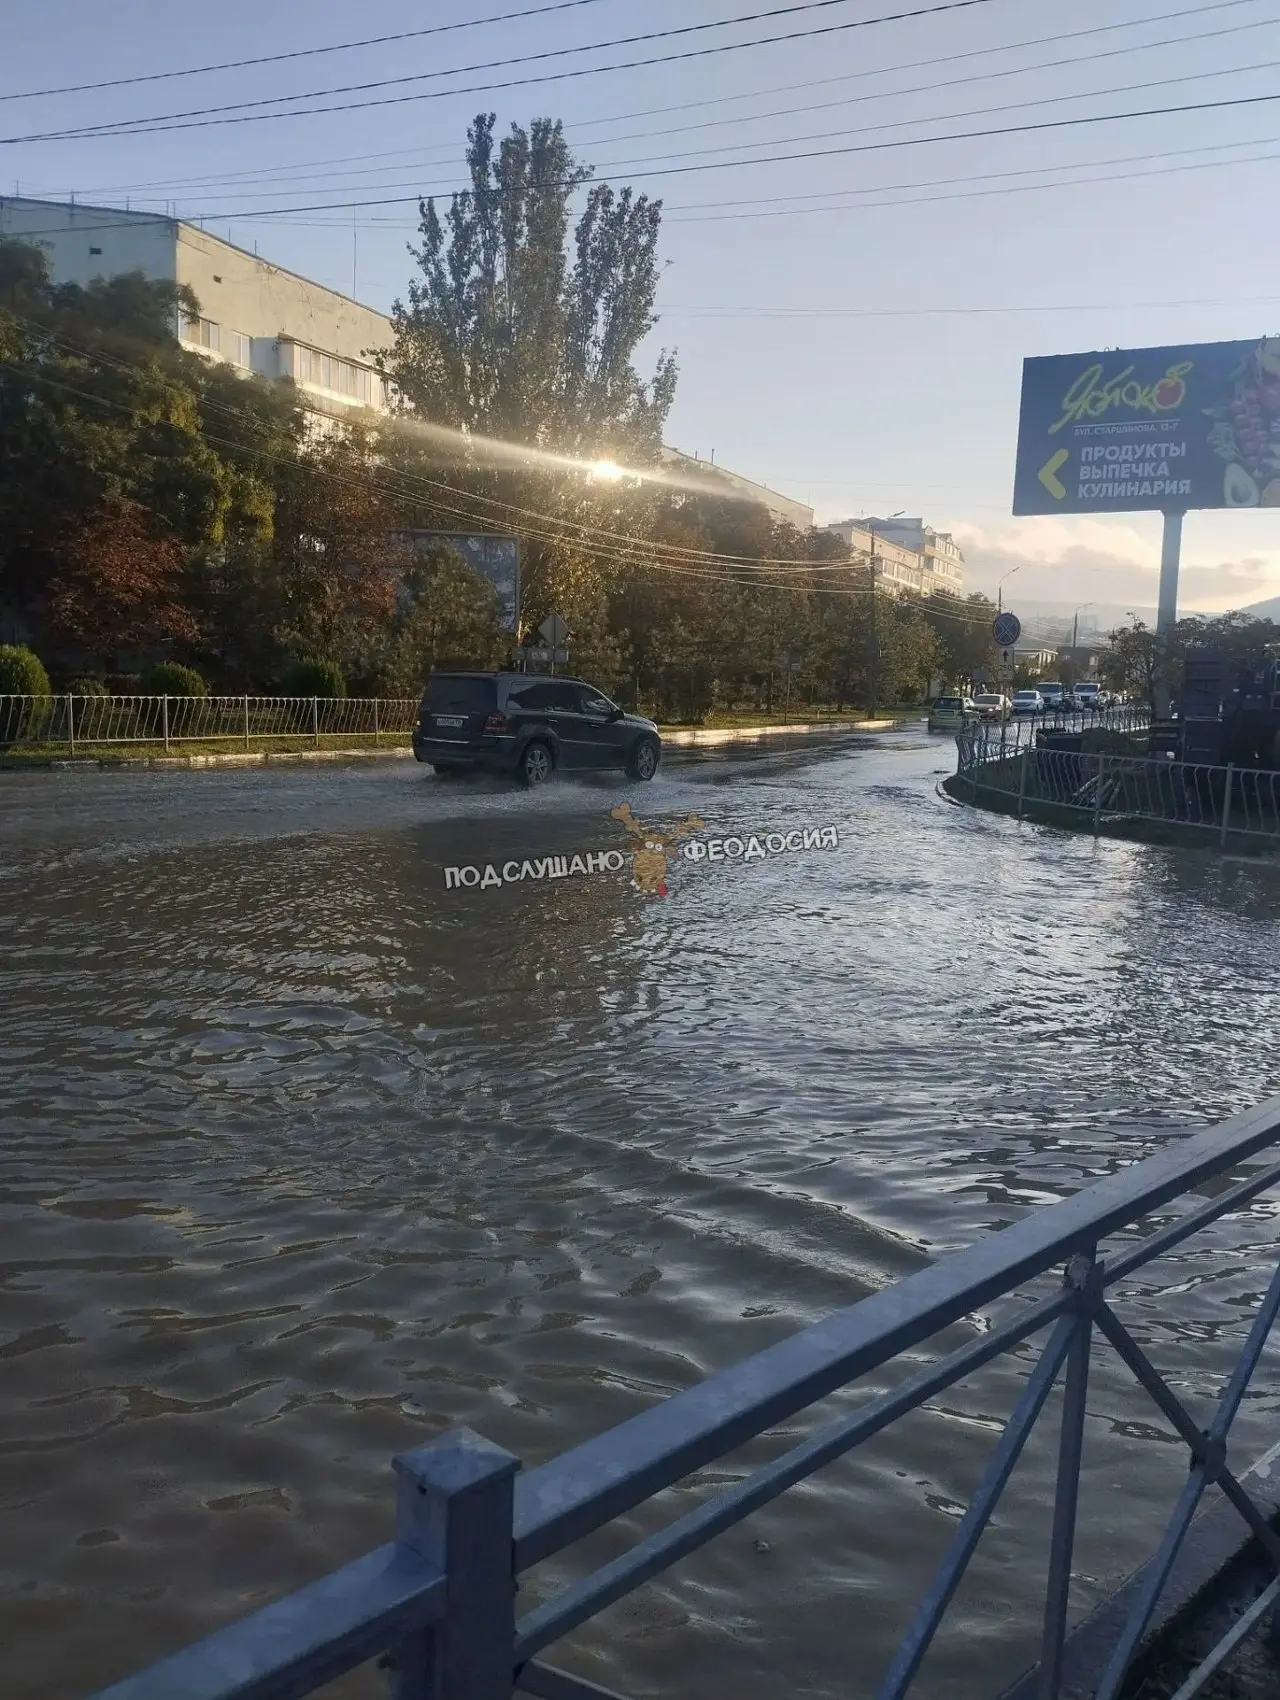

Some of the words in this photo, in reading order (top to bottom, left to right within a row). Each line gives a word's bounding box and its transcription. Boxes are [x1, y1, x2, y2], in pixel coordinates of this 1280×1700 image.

[1081, 442, 1187, 462] ПРОДУКТЫ
[1079, 461, 1170, 480] ВЫПЕЧКА
[1077, 479, 1192, 499] КУЛИНАРИЯ
